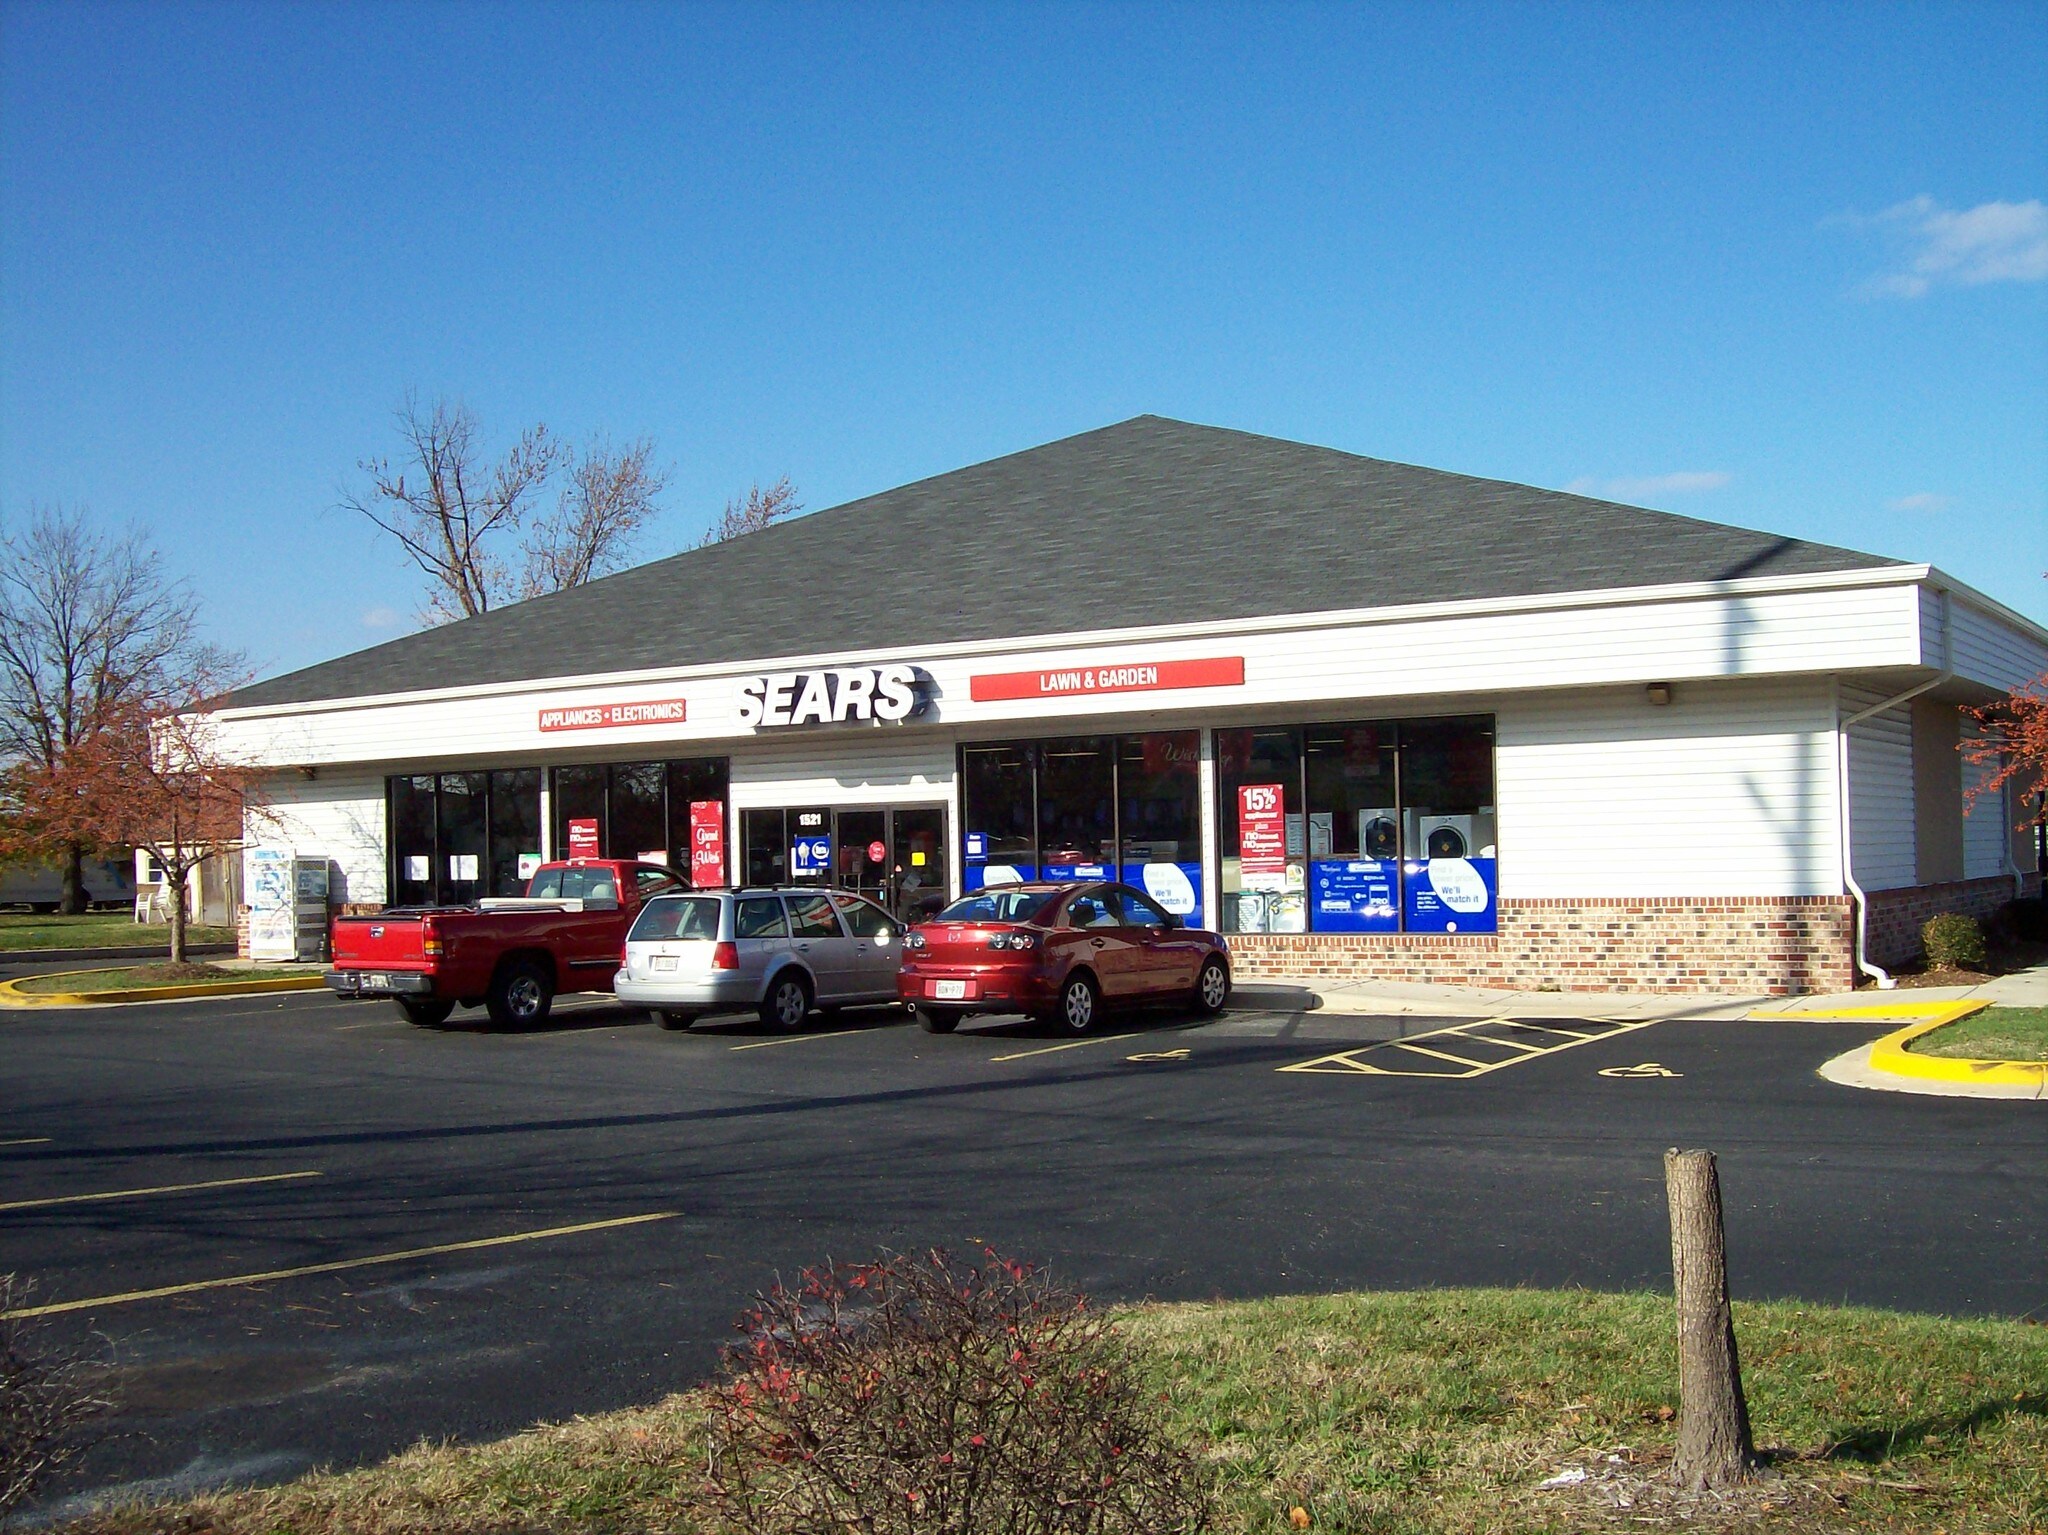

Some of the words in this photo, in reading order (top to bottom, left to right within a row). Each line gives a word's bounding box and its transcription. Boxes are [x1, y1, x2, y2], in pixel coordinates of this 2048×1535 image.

[1040, 672, 1081, 692] LAWN
[1084, 671, 1095, 689] &
[1098, 667, 1158, 688] GARDEN
[728, 665, 916, 728] SEARS
[540, 708, 602, 728] APPLIANCES
[612, 702, 683, 723] ELECTRONICS
[1243, 788, 1277, 811] 15%
[799, 813, 821, 826] 1521
[1160, 897, 1181, 905] match
[1446, 895, 1472, 903] match
[1473, 895, 1479, 903] it
